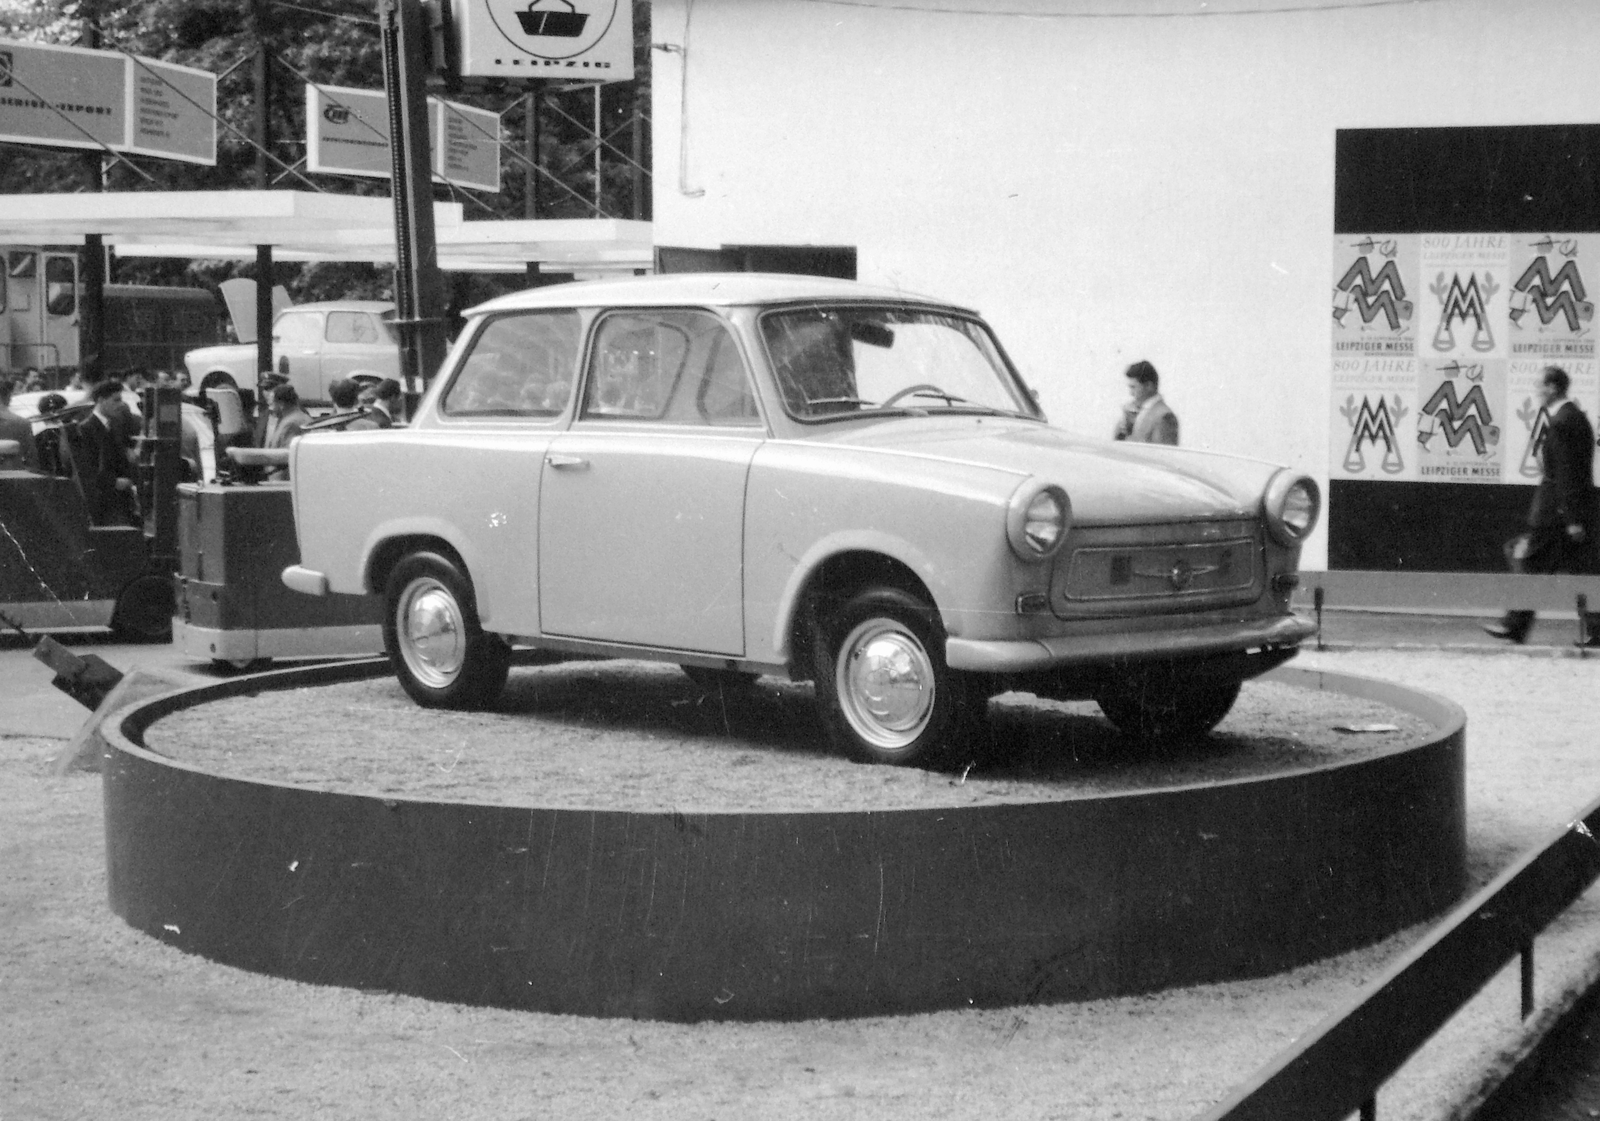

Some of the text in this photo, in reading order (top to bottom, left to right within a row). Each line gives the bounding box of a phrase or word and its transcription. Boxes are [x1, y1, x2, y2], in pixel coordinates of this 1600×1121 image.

[1336, 341, 1414, 352] LEIPZIGER MESSE
[1512, 343, 1595, 353] LEIPZIGER MESSE
[1421, 466, 1500, 476] LEIPZIGER MESSE
